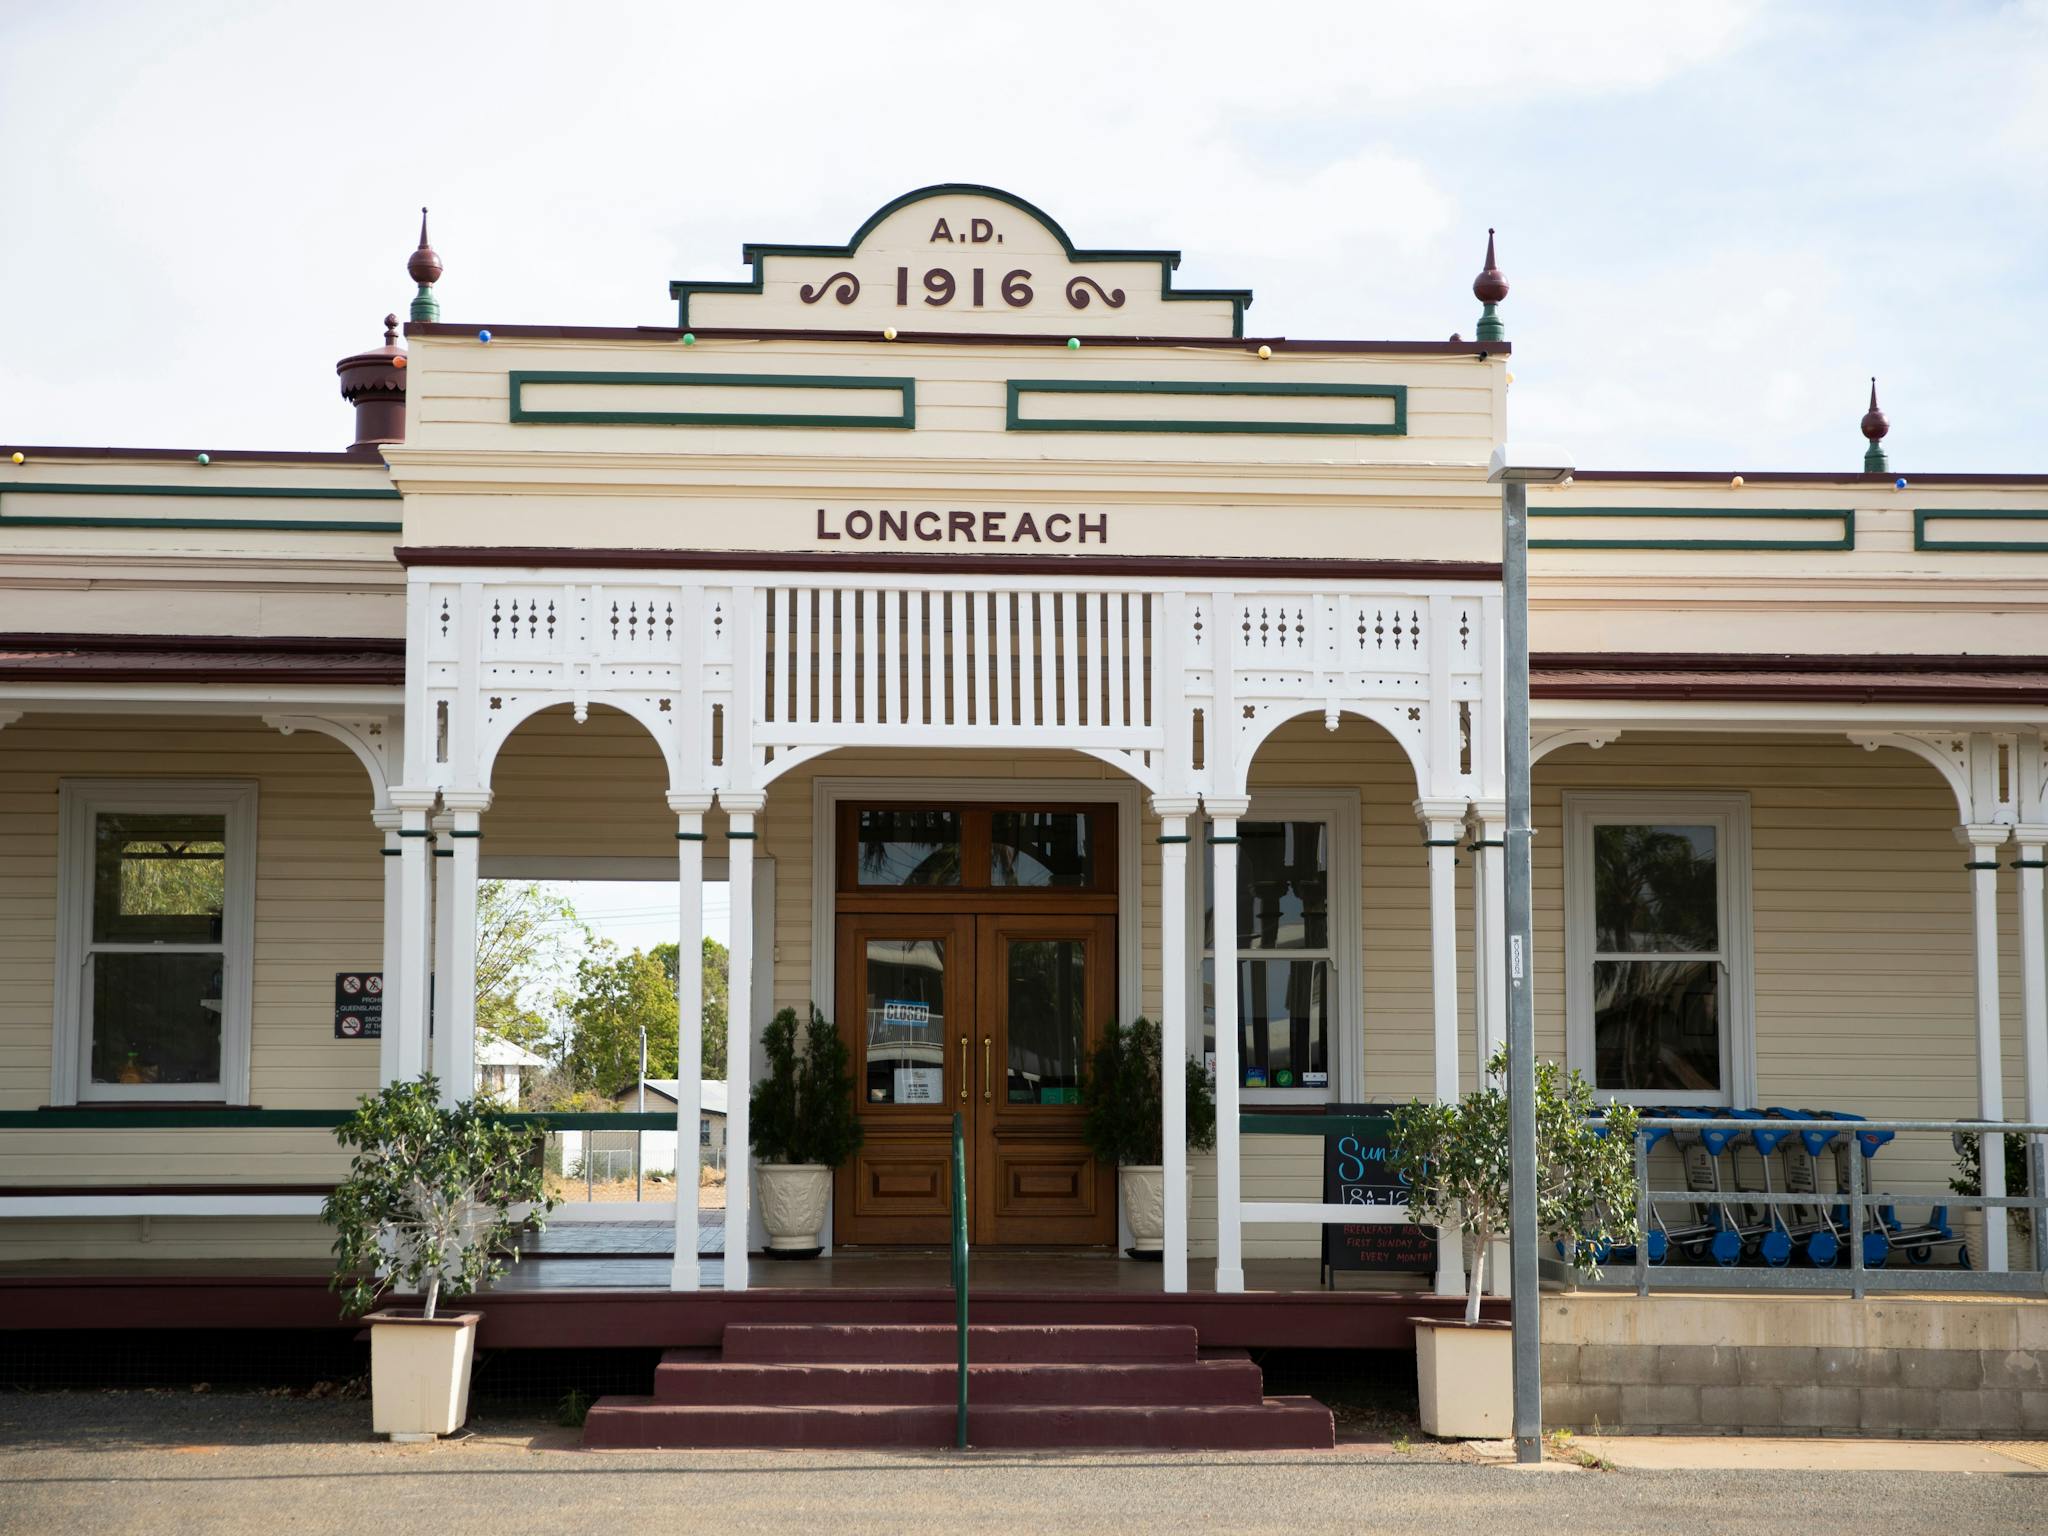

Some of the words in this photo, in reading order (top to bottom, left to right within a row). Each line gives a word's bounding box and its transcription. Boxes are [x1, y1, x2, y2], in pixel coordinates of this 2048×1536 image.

[930, 217, 1003, 244] A.D.
[896, 266, 1034, 308] 1916
[816, 508, 1107, 545] LONGREACH
[886, 1004, 928, 1022] CLOSED
[1346, 1238, 1372, 1247] FIRST
[1376, 1238, 1413, 1248] SUNDAY
[1360, 1250, 1390, 1262] EVERY
